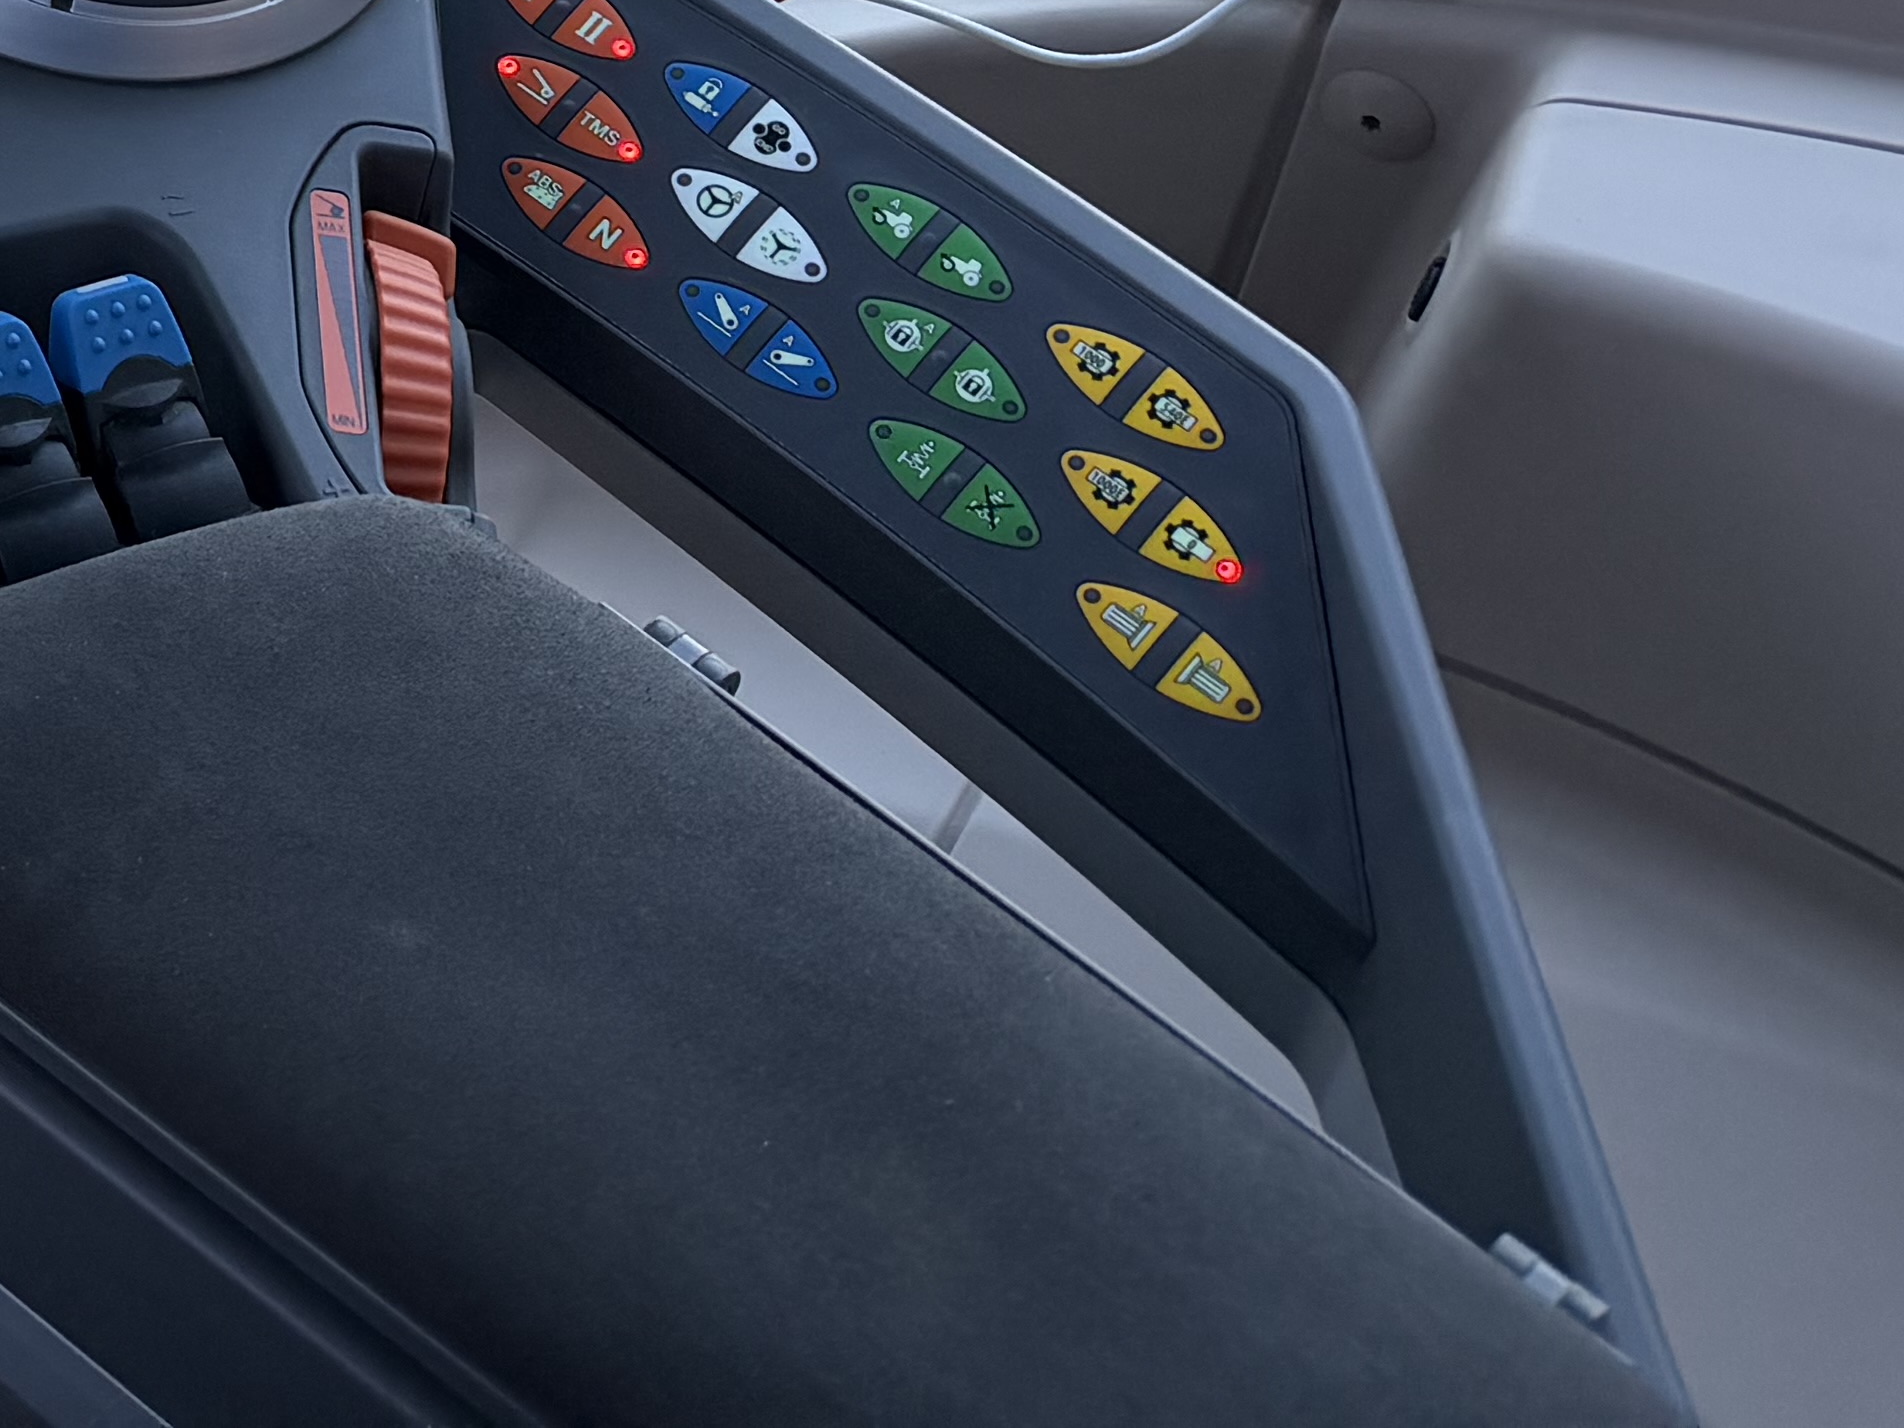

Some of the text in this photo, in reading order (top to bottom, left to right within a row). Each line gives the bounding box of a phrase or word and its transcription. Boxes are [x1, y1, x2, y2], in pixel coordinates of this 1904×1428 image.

[579, 110, 621, 147] TMS
[527, 169, 565, 195] ABS
[317, 221, 346, 234] MAX
[589, 218, 623, 251] N
[1079, 345, 1106, 368] 1000
[331, 414, 356, 428] MIN
